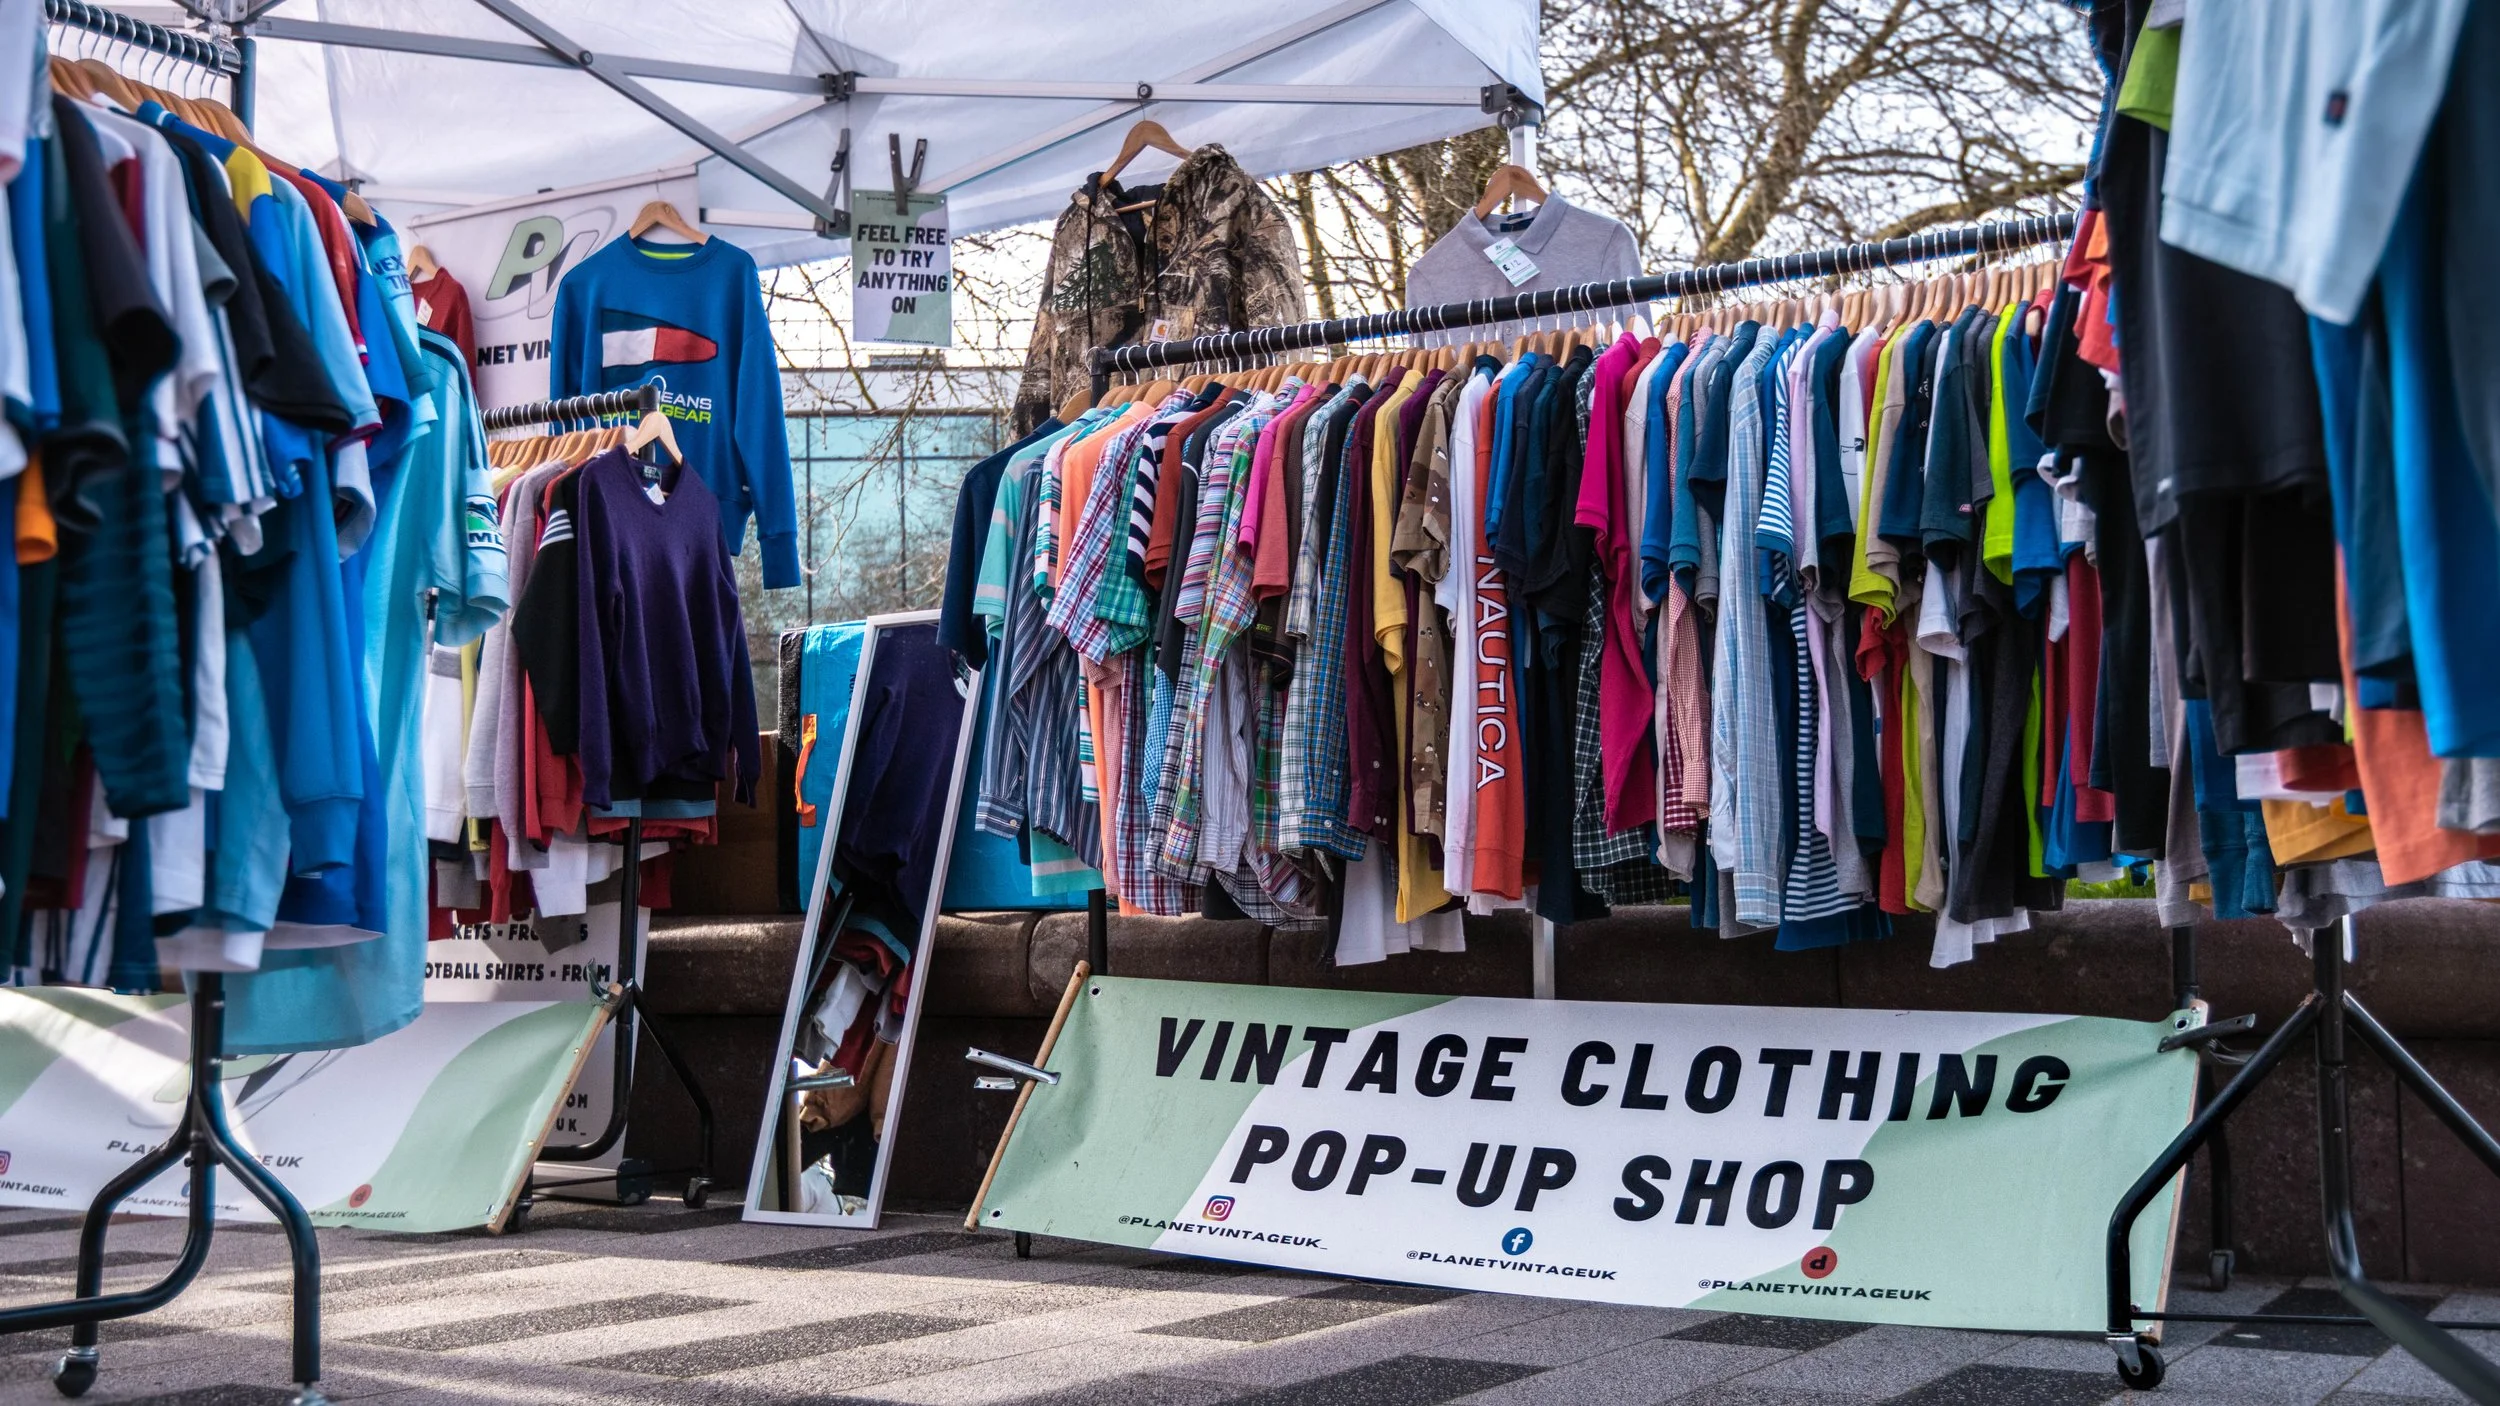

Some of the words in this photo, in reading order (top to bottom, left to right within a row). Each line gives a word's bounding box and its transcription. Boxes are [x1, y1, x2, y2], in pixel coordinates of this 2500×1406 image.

[857, 224, 900, 243] FEEL
[904, 226, 946, 245] FREE
[873, 248, 895, 266] TO
[901, 249, 934, 268] TRY
[857, 271, 948, 292] ANYTHING
[891, 296, 916, 314] ON
[1476, 555, 1508, 792] NAUTICA
[486, 963, 544, 980] SHIRTS
[1156, 1017, 1529, 1101] VINTAGE
[1561, 1041, 2070, 1121] CLOTHING
[276, 1155, 304, 1168] UK
[1229, 1125, 1577, 1212] POP-UP
[1613, 1155, 1874, 1230] SHOP
[1118, 1215, 1328, 1250] @PLANETVINTAGEUK_
[1406, 1250, 1617, 1280] @PLANETVINTAGEUK
[1698, 1279, 1932, 1300] @PLANETVINTAGEUK
